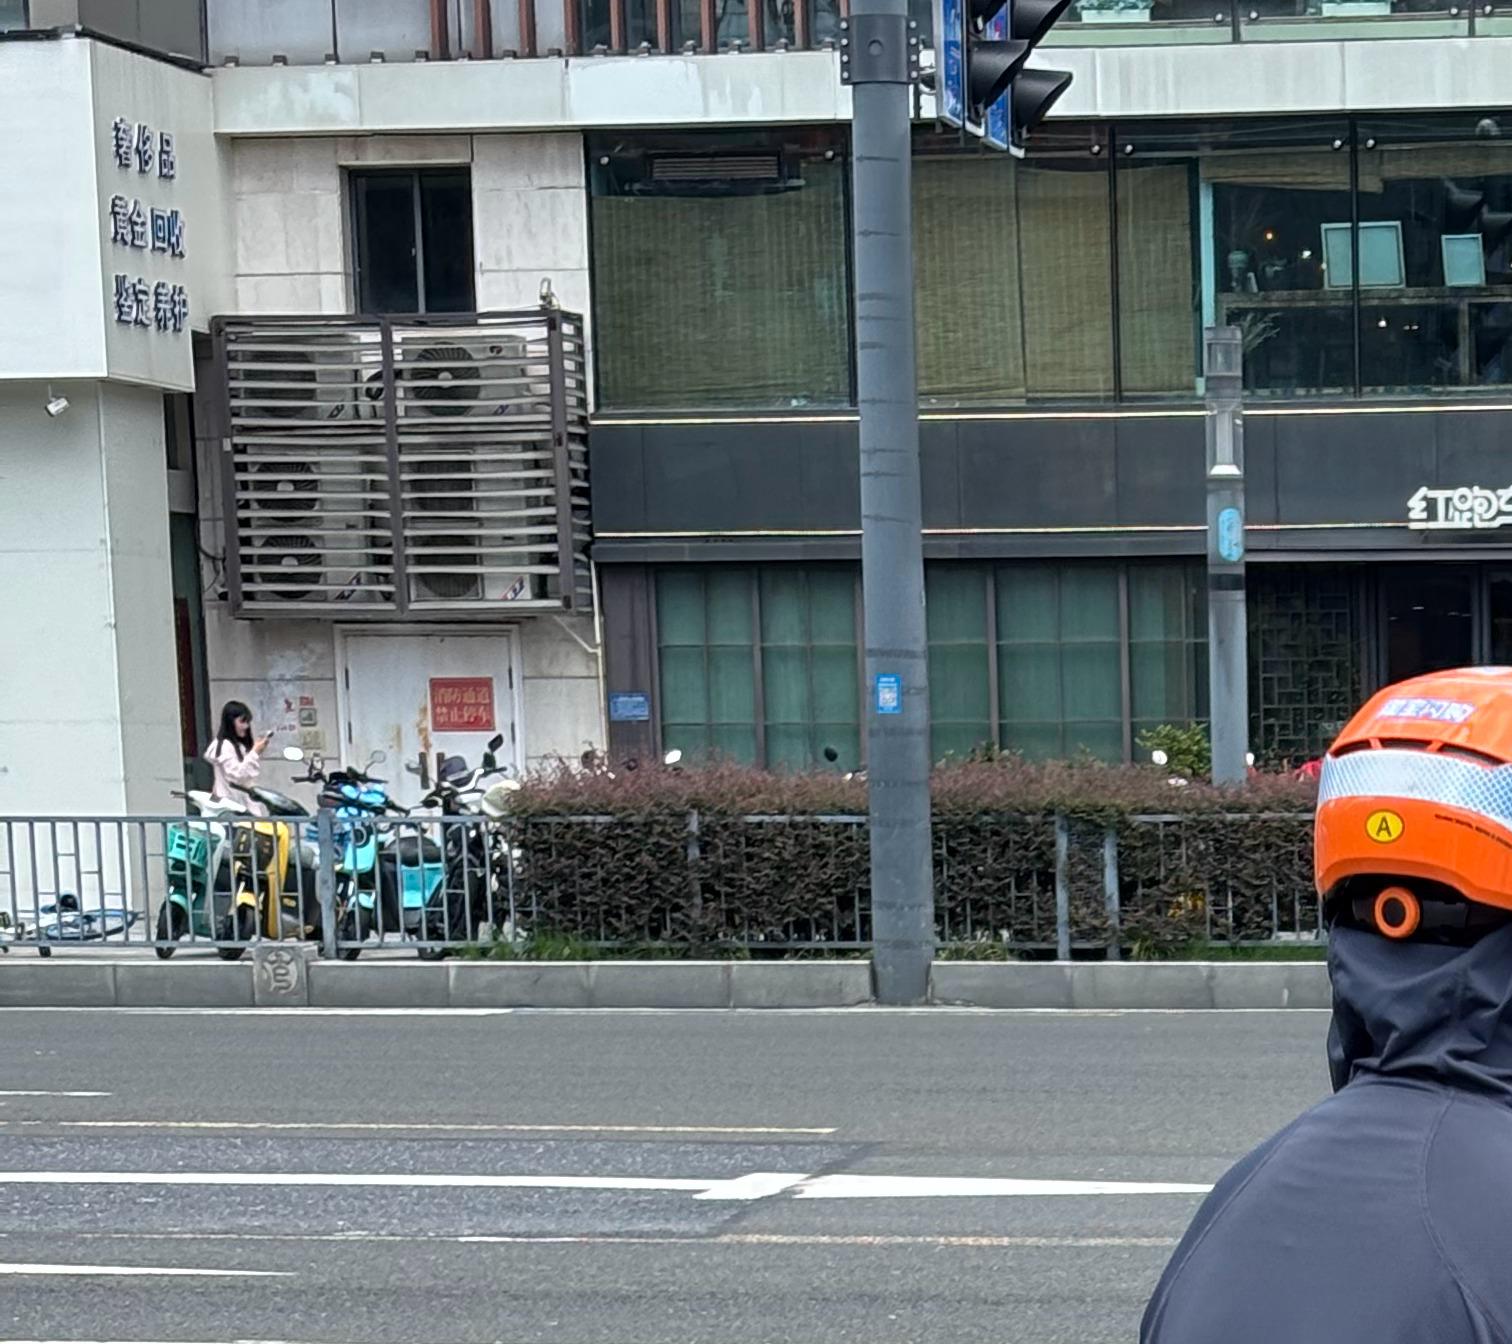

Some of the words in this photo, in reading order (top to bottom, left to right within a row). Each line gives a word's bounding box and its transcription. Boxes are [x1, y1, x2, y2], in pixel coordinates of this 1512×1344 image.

[111, 118, 176, 180] 奢侈品
[110, 195, 186, 258] 黄金回收
[114, 274, 190, 333] 鉴定养护
[435, 706, 491, 723] 禁止停车
[1376, 815, 1392, 837] A
